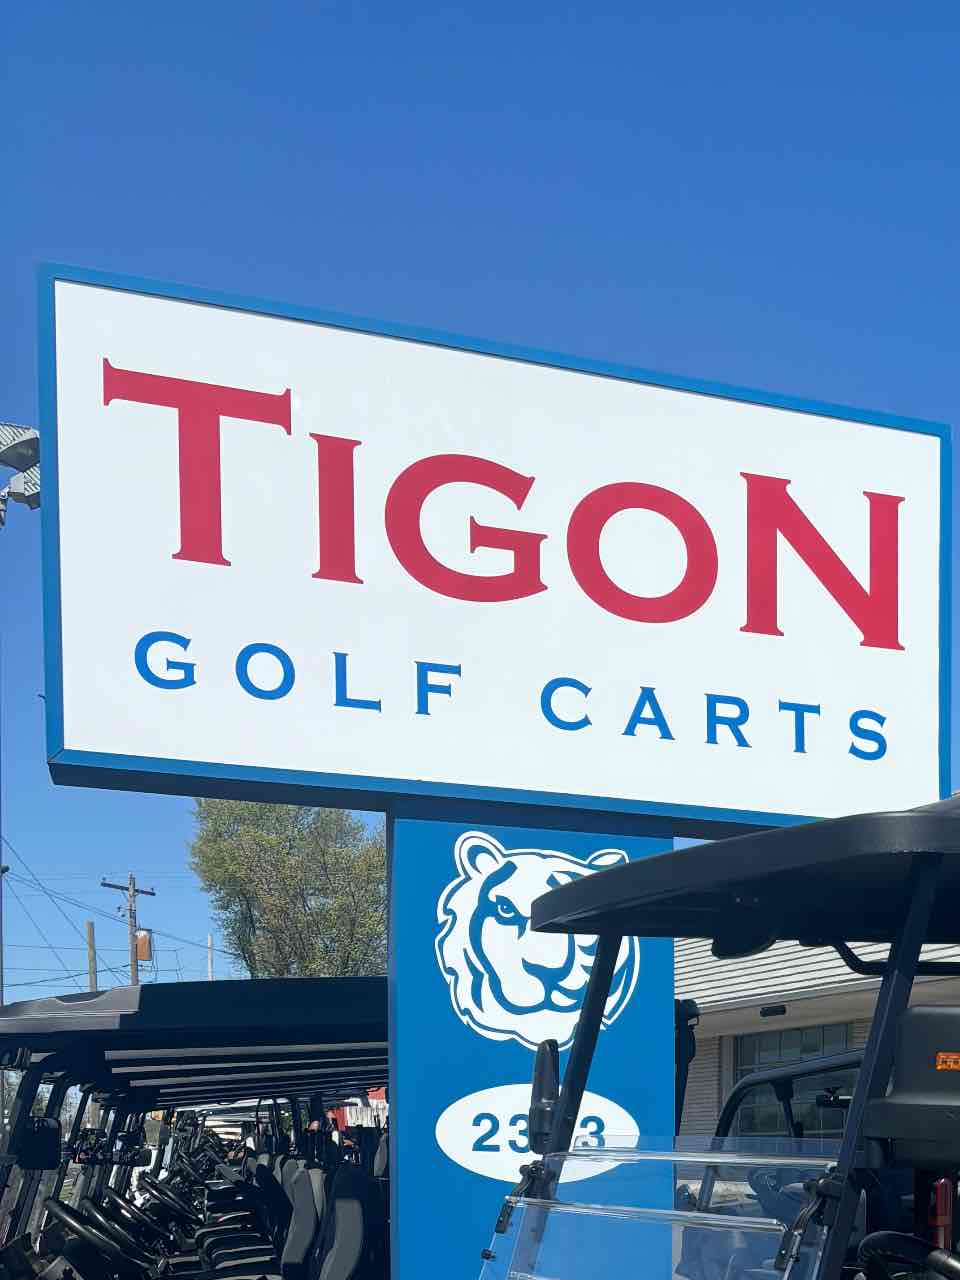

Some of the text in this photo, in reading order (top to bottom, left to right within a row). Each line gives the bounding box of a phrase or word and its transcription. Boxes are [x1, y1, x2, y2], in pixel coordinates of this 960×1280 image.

[102, 357, 906, 651] TIGON
[134, 630, 888, 761] GOLF CARTS
[471, 1112, 606, 1154] 233
